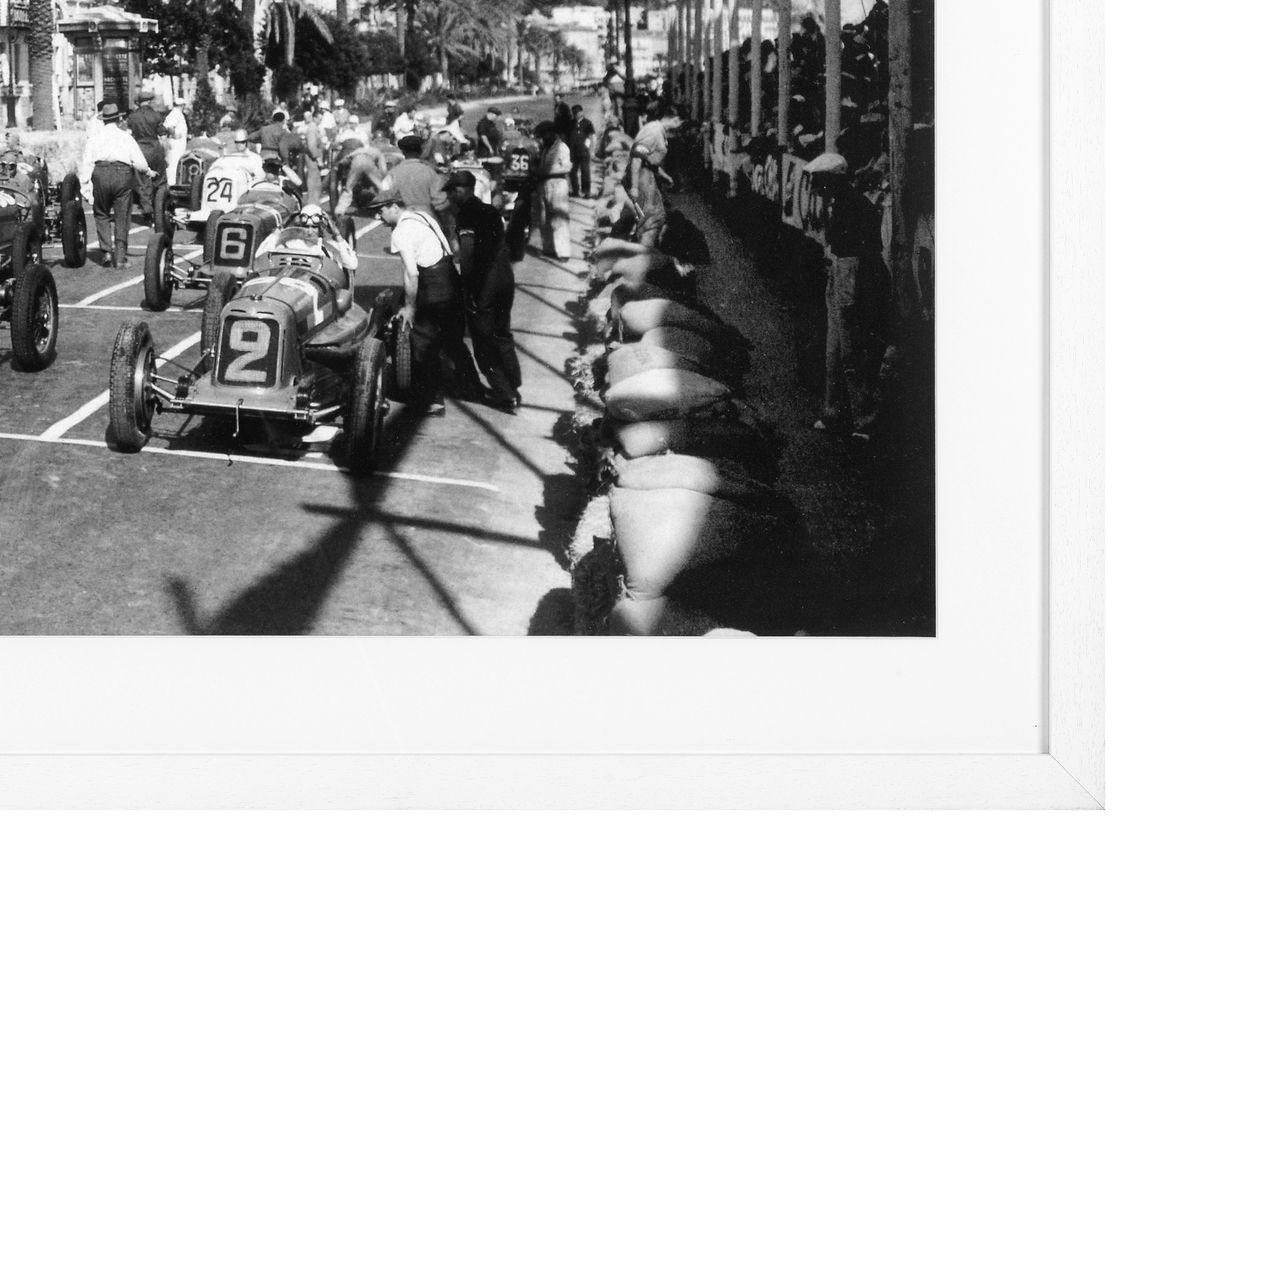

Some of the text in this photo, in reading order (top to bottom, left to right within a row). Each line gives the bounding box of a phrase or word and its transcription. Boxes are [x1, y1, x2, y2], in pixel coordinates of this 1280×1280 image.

[511, 153, 529, 170] 36
[206, 181, 232, 202] 24
[220, 227, 247, 260] 6
[224, 319, 271, 382] 2
